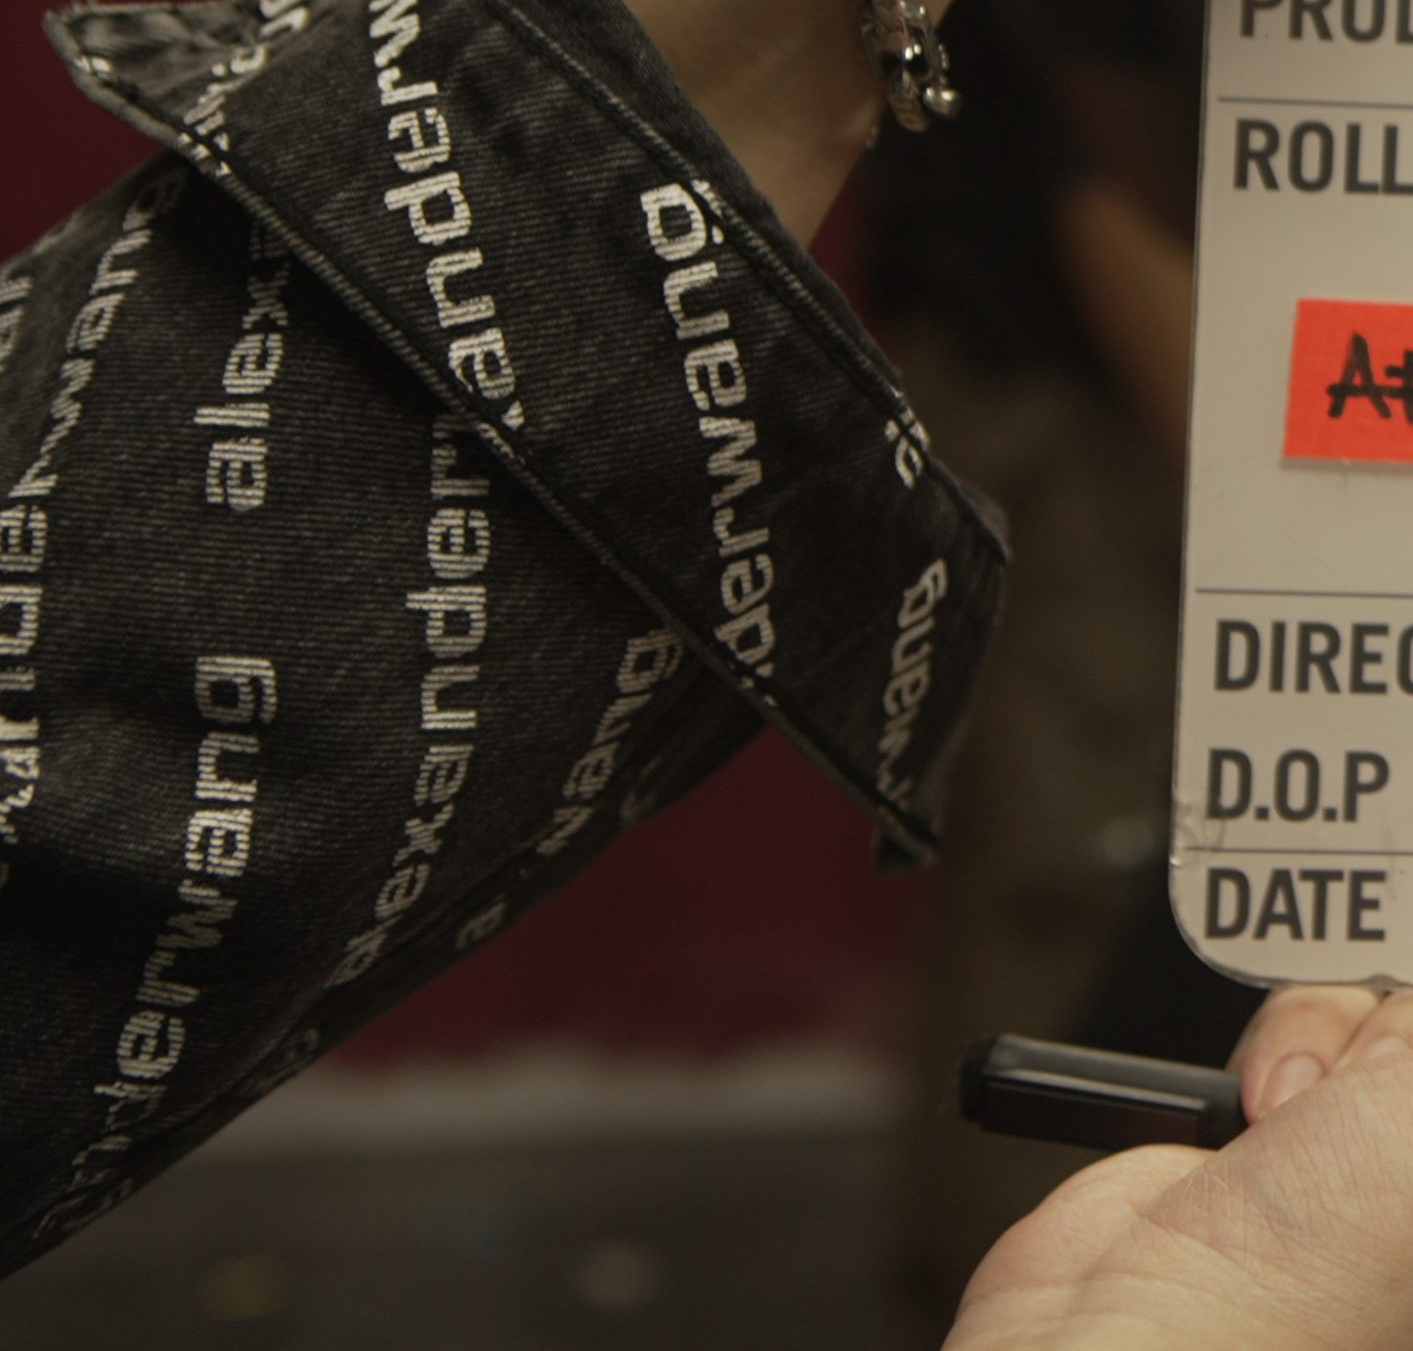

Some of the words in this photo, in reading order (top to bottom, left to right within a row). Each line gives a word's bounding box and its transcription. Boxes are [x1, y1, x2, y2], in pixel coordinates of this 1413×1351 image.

[640, 179, 776, 679] derwang
[1206, 747, 1391, 822] D.O.P
[1203, 867, 1388, 943] DATE
